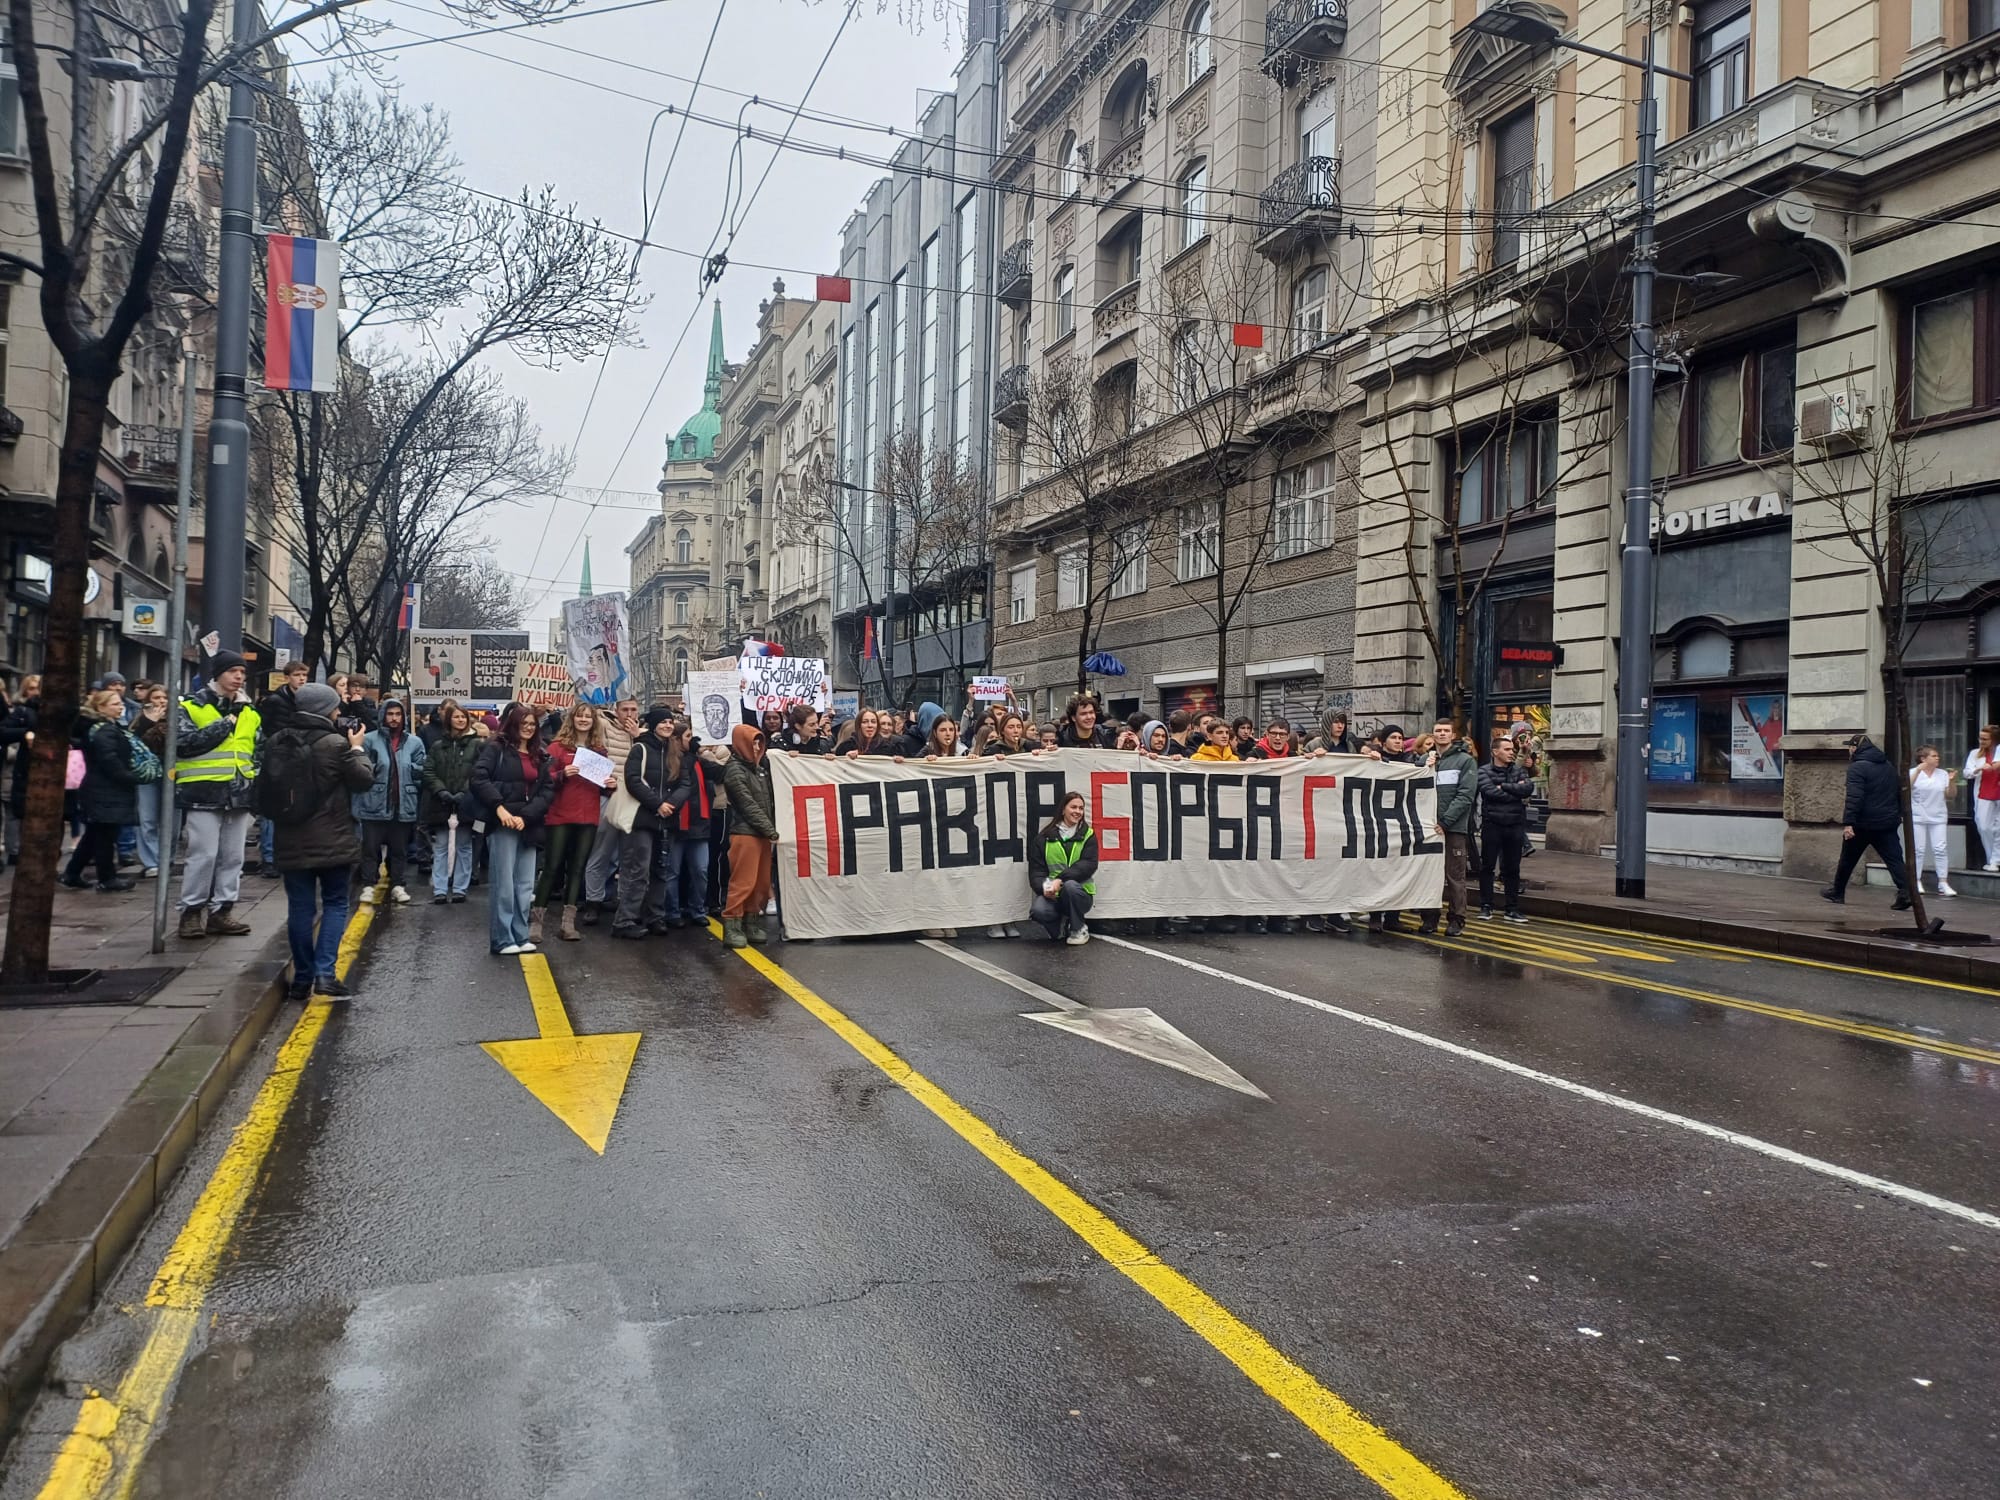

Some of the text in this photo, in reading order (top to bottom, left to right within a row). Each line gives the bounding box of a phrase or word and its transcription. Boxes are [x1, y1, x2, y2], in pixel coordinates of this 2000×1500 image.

[1620, 492, 1783, 544] POTEKA
[519, 651, 544, 663] ИЛИ
[748, 656, 772, 670] ГДЕ
[778, 657, 796, 671] ДА
[802, 659, 819, 671] СЕ
[519, 677, 547, 690] ИЛИ
[548, 680, 565, 692] СИ
[761, 670, 823, 684] СКЛОНИМО
[747, 680, 770, 696] АКО
[775, 683, 792, 697] СЕ
[794, 684, 820, 699] СВЕ
[792, 771, 1444, 878] ПРАВДА БОРБА ГЛАС
